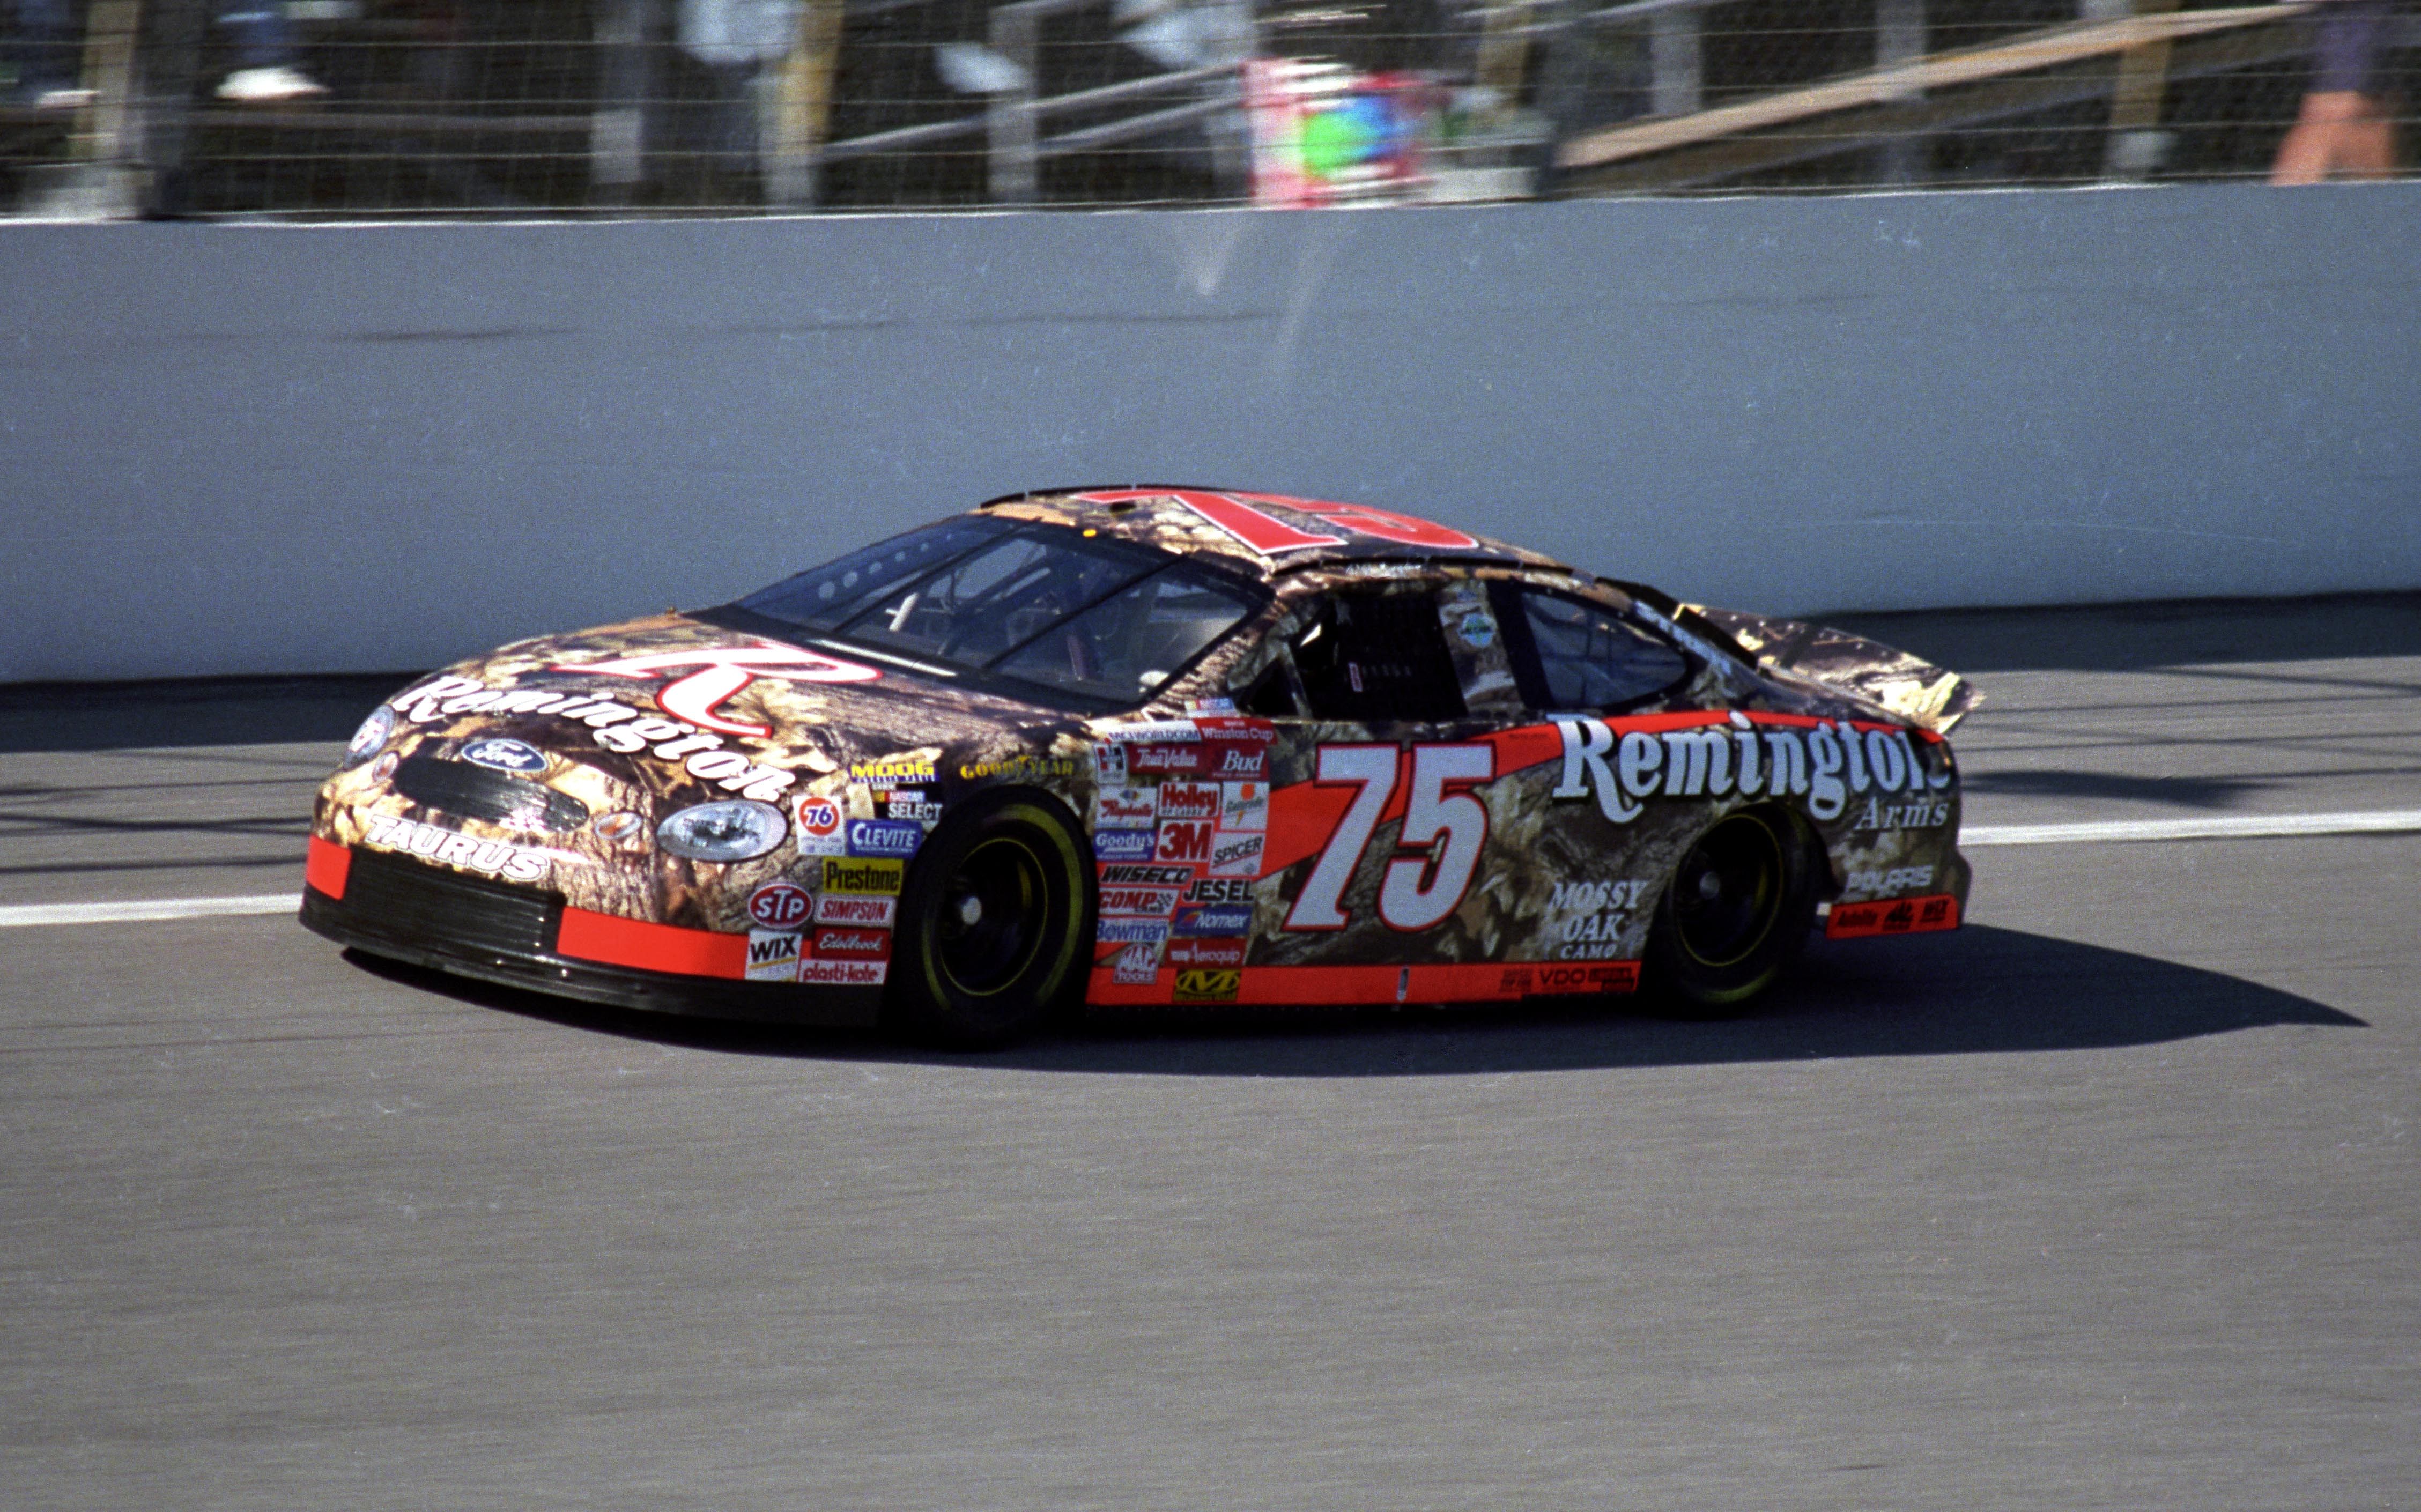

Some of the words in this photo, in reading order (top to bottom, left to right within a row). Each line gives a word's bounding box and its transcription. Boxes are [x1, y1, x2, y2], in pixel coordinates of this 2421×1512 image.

[394, 675, 796, 802] Remington
[1202, 727, 1248, 739] Winston
[1249, 727, 1274, 742] Cup
[472, 742, 532, 767] Ford
[1222, 749, 1265, 772] Bud
[851, 762, 935, 777] MOOG
[960, 755, 1073, 780] GOODYEAR
[887, 802, 943, 820] SELECT
[1161, 783, 1218, 817] Holley
[805, 807, 833, 826] 76
[1853, 797, 1949, 831] Arms
[852, 824, 916, 847] CLEVITE
[1096, 833, 1154, 850] Goody's
[1159, 823, 1212, 859] 3M
[1282, 740, 1497, 932] 75
[366, 815, 550, 883] TAURUS
[1213, 836, 1263, 864] SPICER
[826, 861, 901, 892] Prestone
[1101, 866, 1194, 884] WISECO
[1100, 892, 1158, 908] COMP
[1183, 880, 1255, 902] JESEL
[1546, 880, 1648, 910] MOSSY
[756, 889, 805, 921] STP
[820, 900, 889, 920] SIMPSON
[1097, 920, 1167, 940] Bowman
[1194, 913, 1248, 928] Nomex
[1562, 913, 1625, 942] OAK
[750, 935, 797, 963] WIX
[818, 932, 884, 952] Edelbrock
[1560, 944, 1618, 959] CAMO
[803, 963, 879, 983] plasti-kote
[1539, 969, 1586, 984] VDO
